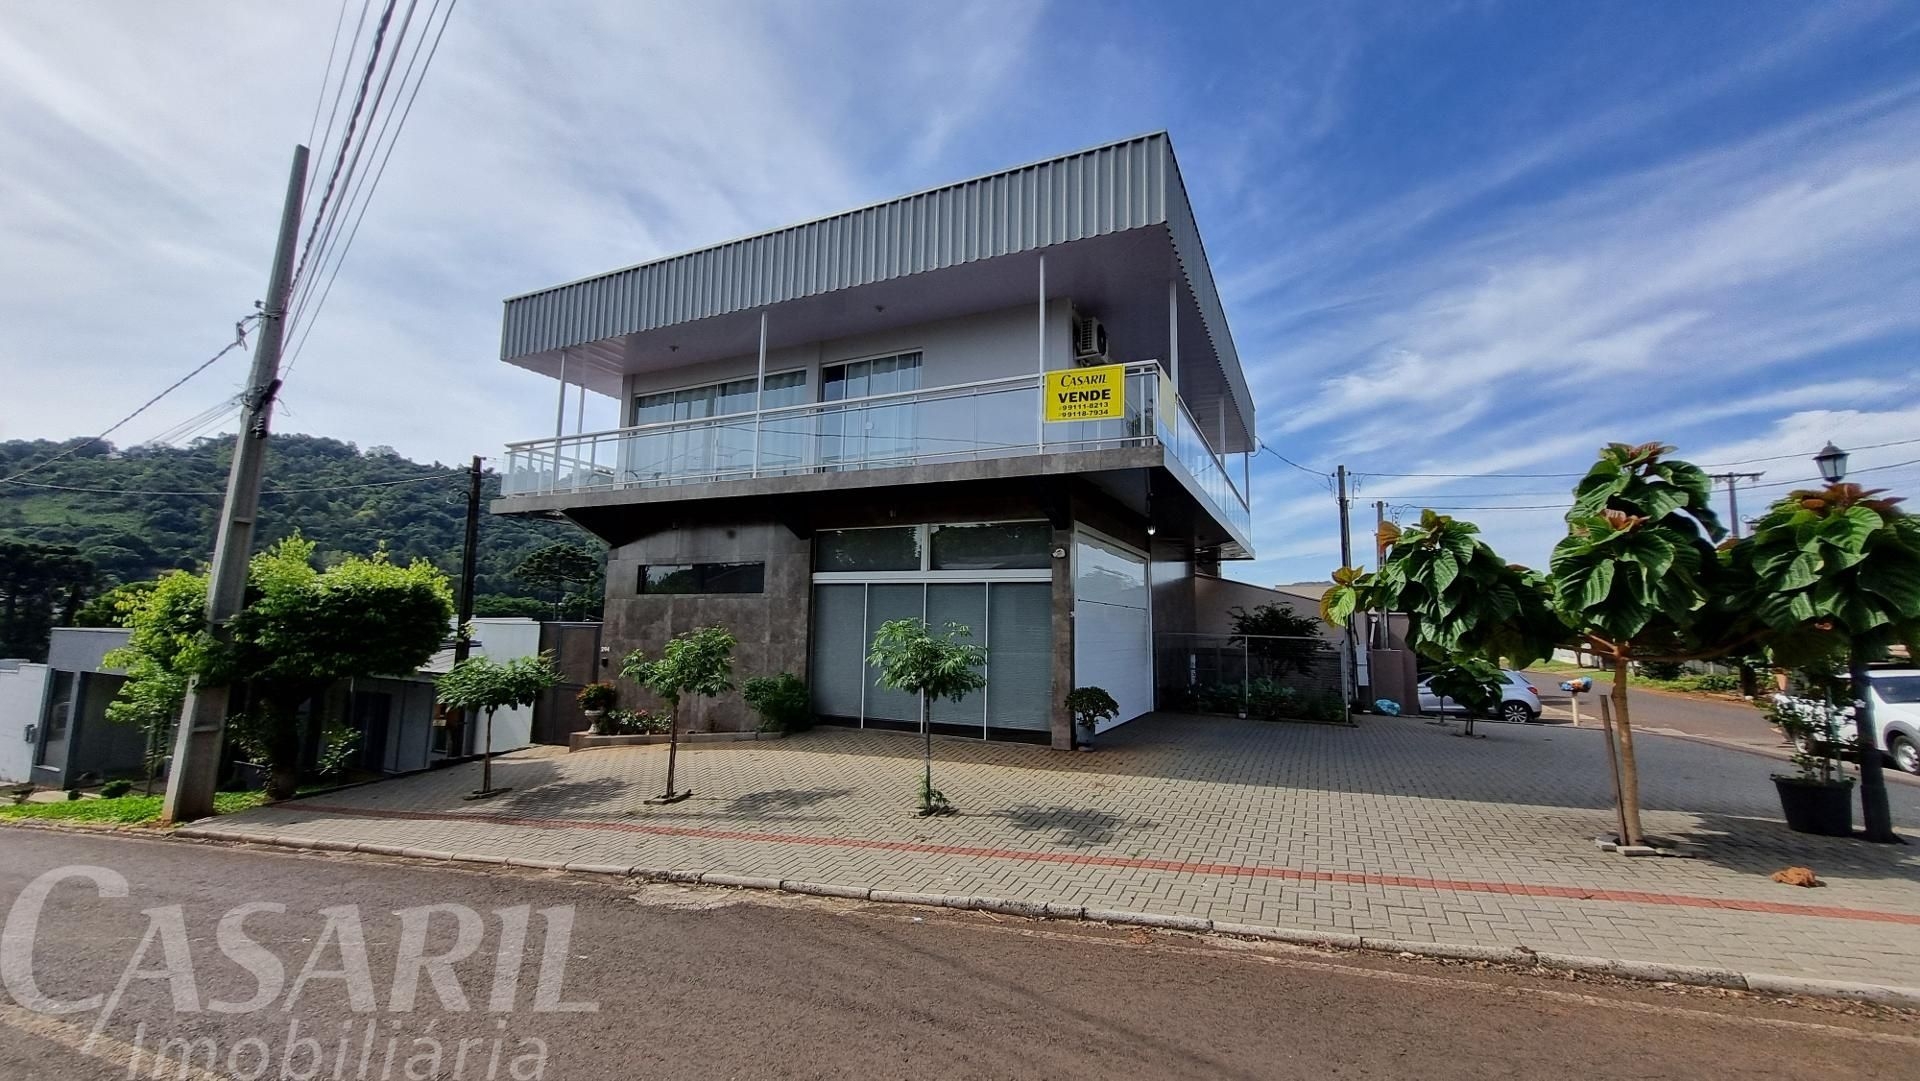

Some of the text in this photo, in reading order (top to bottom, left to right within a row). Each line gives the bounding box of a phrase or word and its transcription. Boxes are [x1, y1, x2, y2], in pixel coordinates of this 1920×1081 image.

[1060, 374, 1107, 389] CASARIL
[1058, 389, 1111, 403] VENDE
[1062, 402, 1109, 410] 99111-8213
